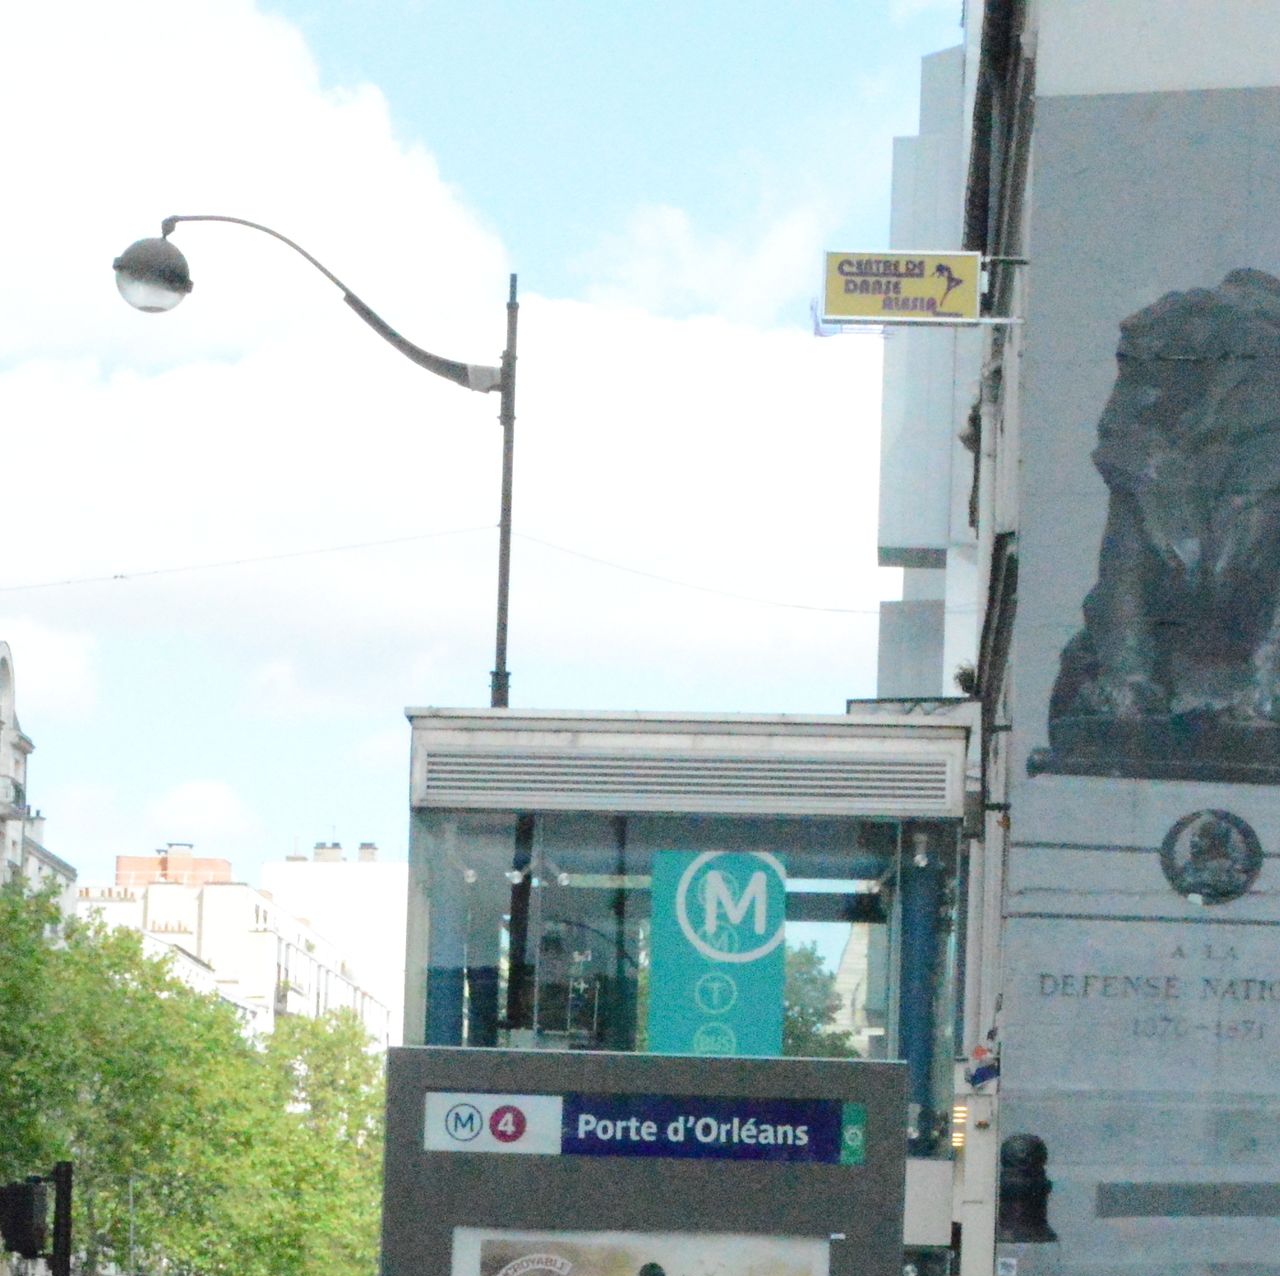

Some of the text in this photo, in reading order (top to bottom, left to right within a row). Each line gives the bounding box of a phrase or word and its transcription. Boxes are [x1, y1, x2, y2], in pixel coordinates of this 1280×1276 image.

[844, 279, 902, 295] DANSE
[1039, 972, 1181, 999] DEFENSE
[496, 1112, 517, 1136] 4
[577, 1113, 658, 1142] Porte
[666, 1115, 810, 1146] d'Orléans
